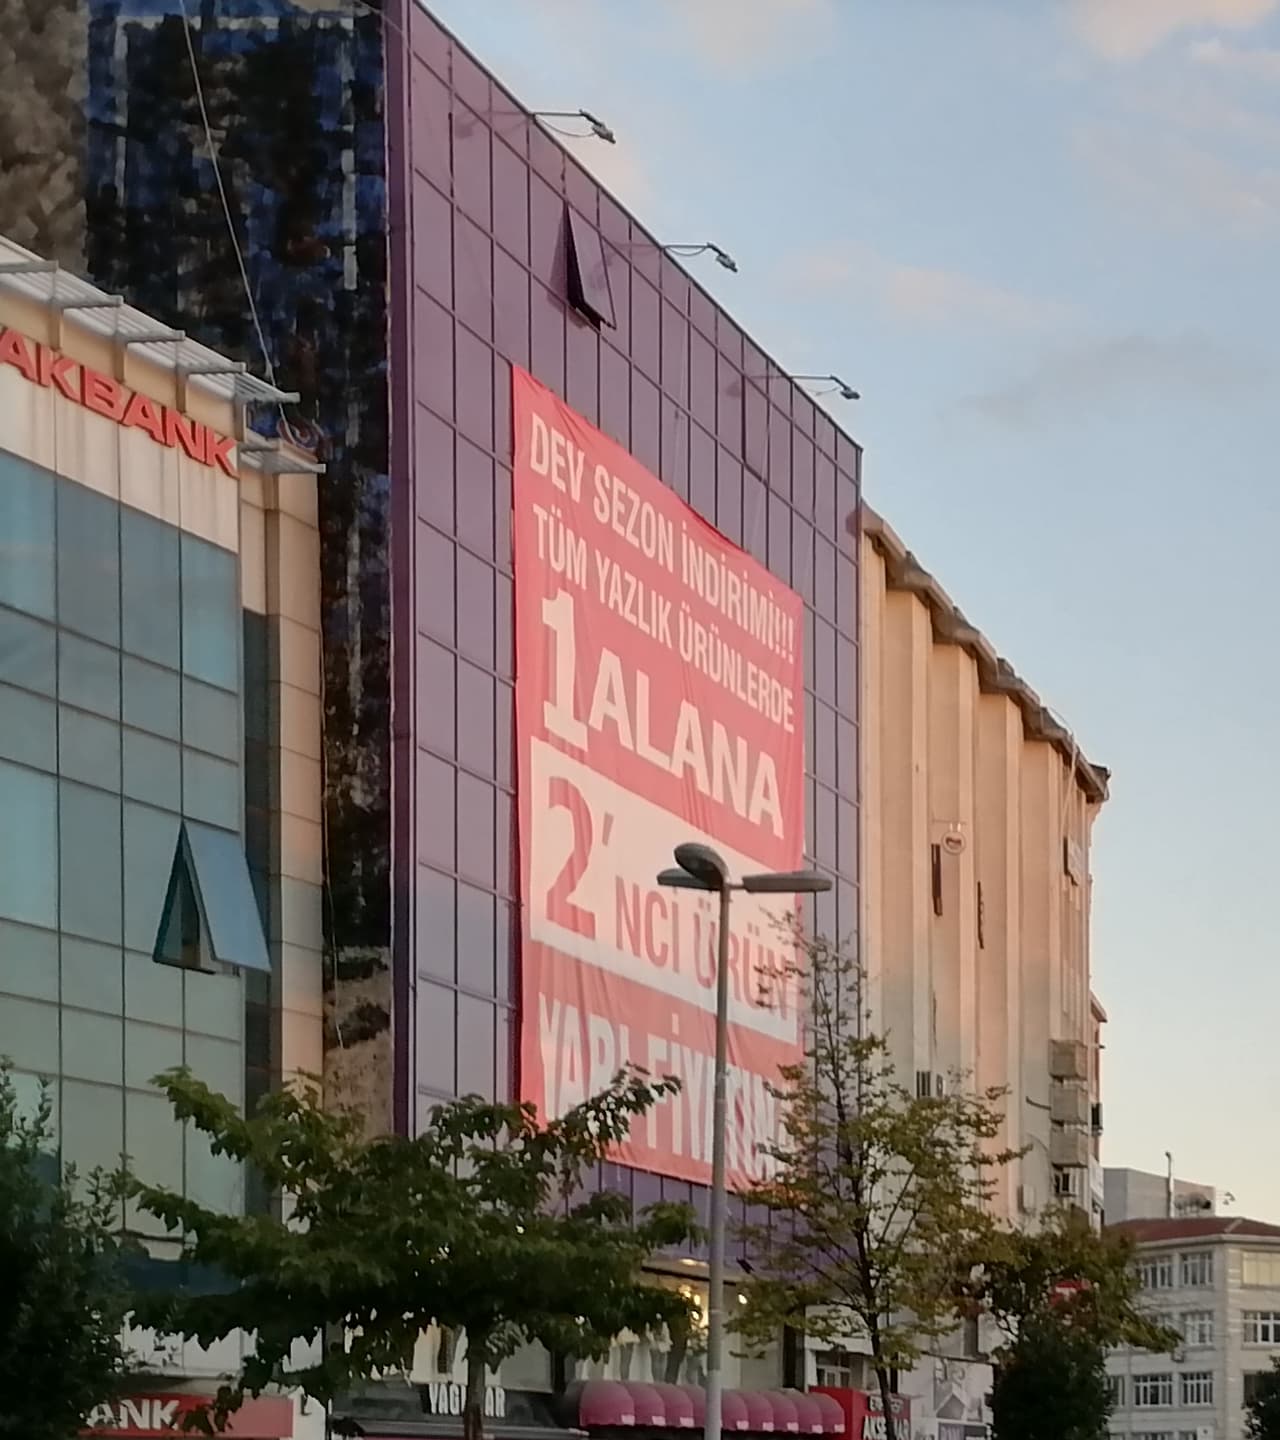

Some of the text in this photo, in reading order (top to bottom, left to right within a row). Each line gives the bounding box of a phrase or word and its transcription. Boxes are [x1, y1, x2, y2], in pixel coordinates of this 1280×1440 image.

[0, 327, 239, 479] AKBANK
[530, 412, 794, 664] DEV SEZON İNDİRİMİ!!!
[533, 503, 794, 733] TÜM YAZLIK ÜRÜNLERDE
[542, 587, 784, 840] 1 ALANA
[694, 900, 789, 1023] ÜRÜN
